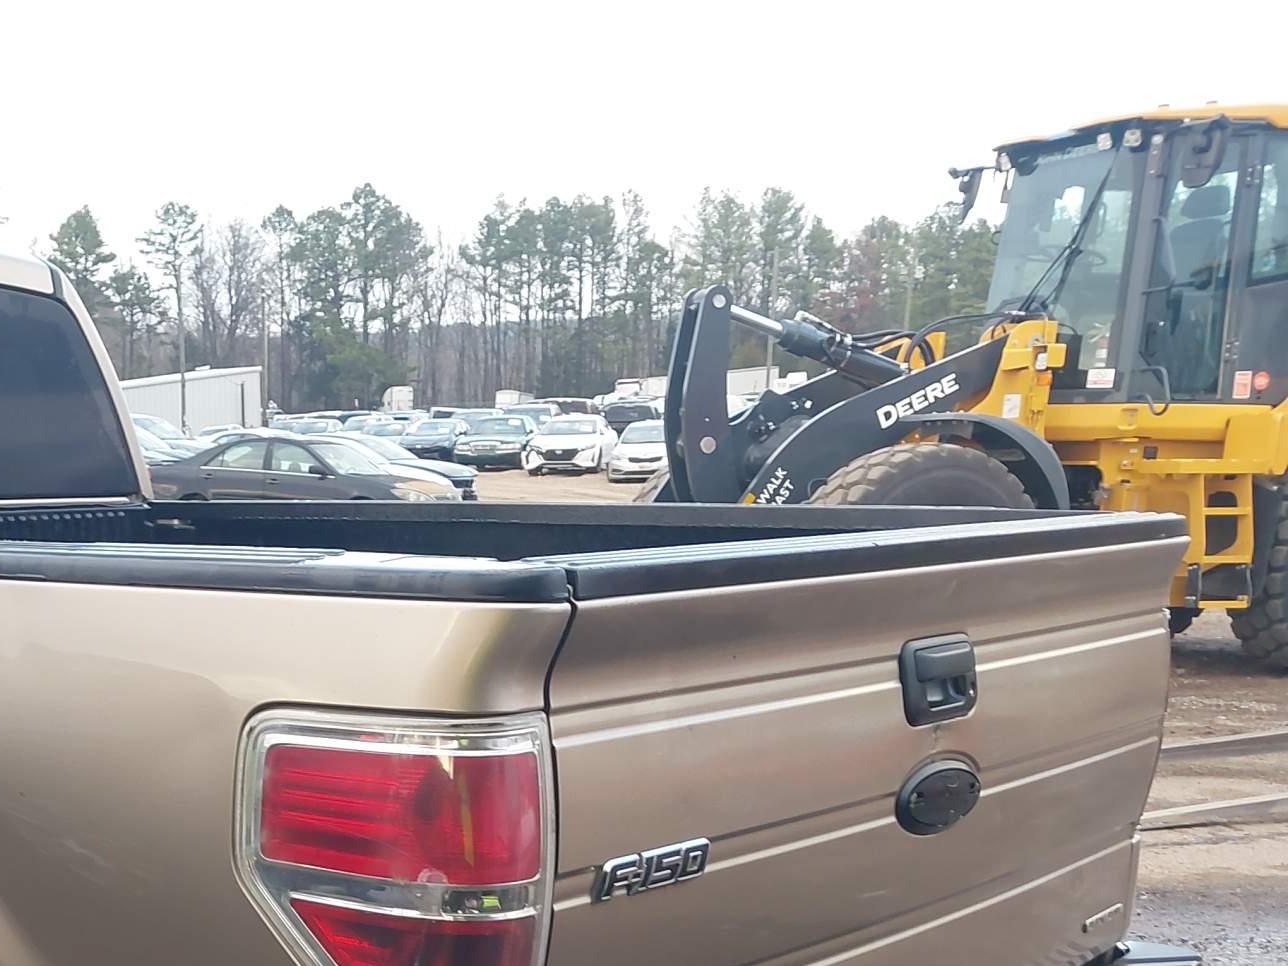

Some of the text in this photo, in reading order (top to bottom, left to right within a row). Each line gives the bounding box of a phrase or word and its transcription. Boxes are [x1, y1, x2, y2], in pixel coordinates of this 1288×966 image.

[876, 373, 960, 429] DEERE
[756, 467, 788, 504] WALK
[772, 479, 794, 505] AST
